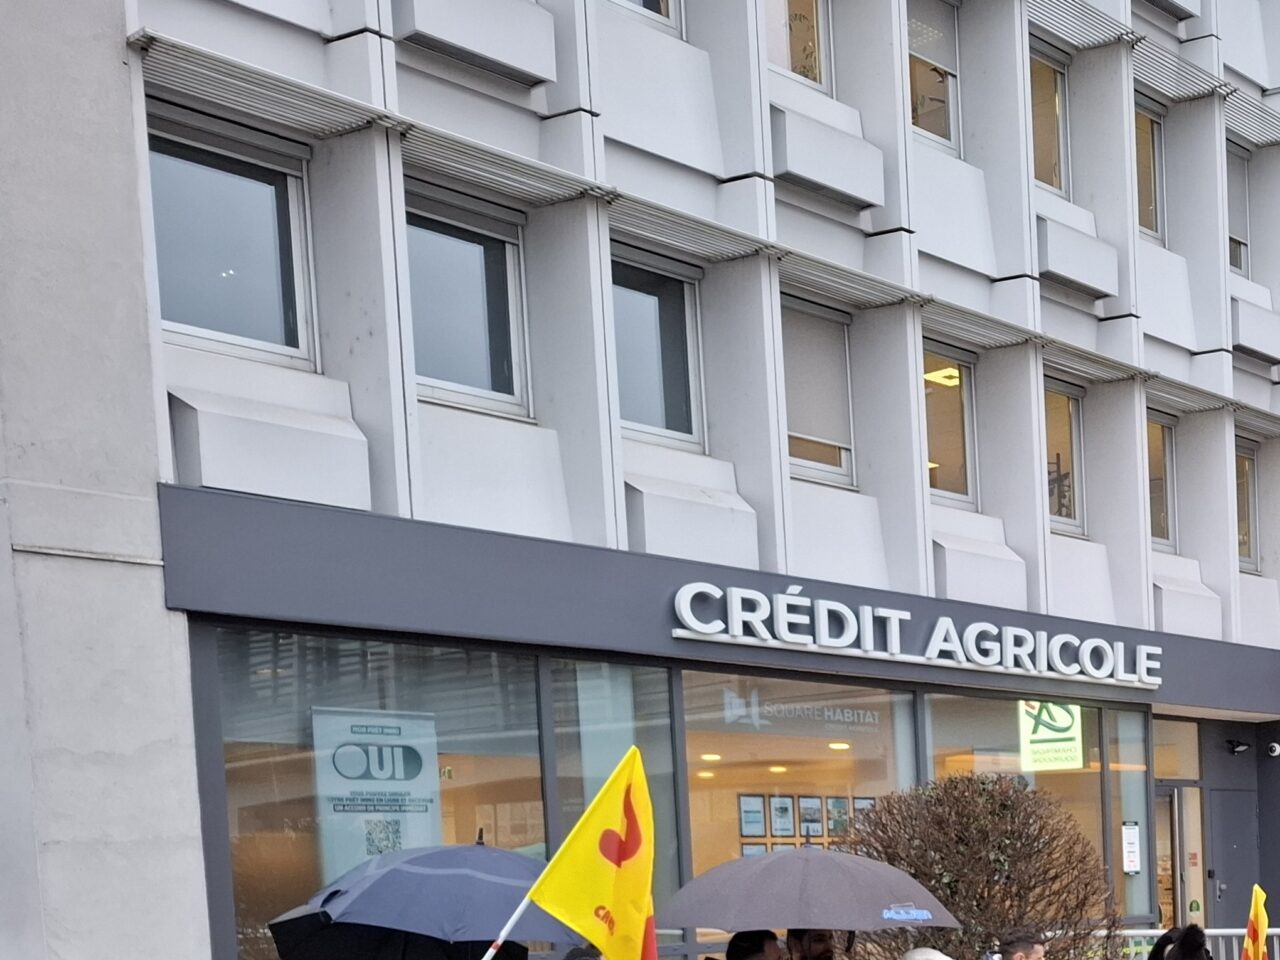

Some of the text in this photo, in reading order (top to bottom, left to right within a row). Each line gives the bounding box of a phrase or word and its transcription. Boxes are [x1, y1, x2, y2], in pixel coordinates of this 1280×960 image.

[674, 582, 1163, 685] CRÉDIT AGRICOLE
[764, 703, 881, 724] SQUARE HABITAT
[333, 744, 405, 780] OUI
